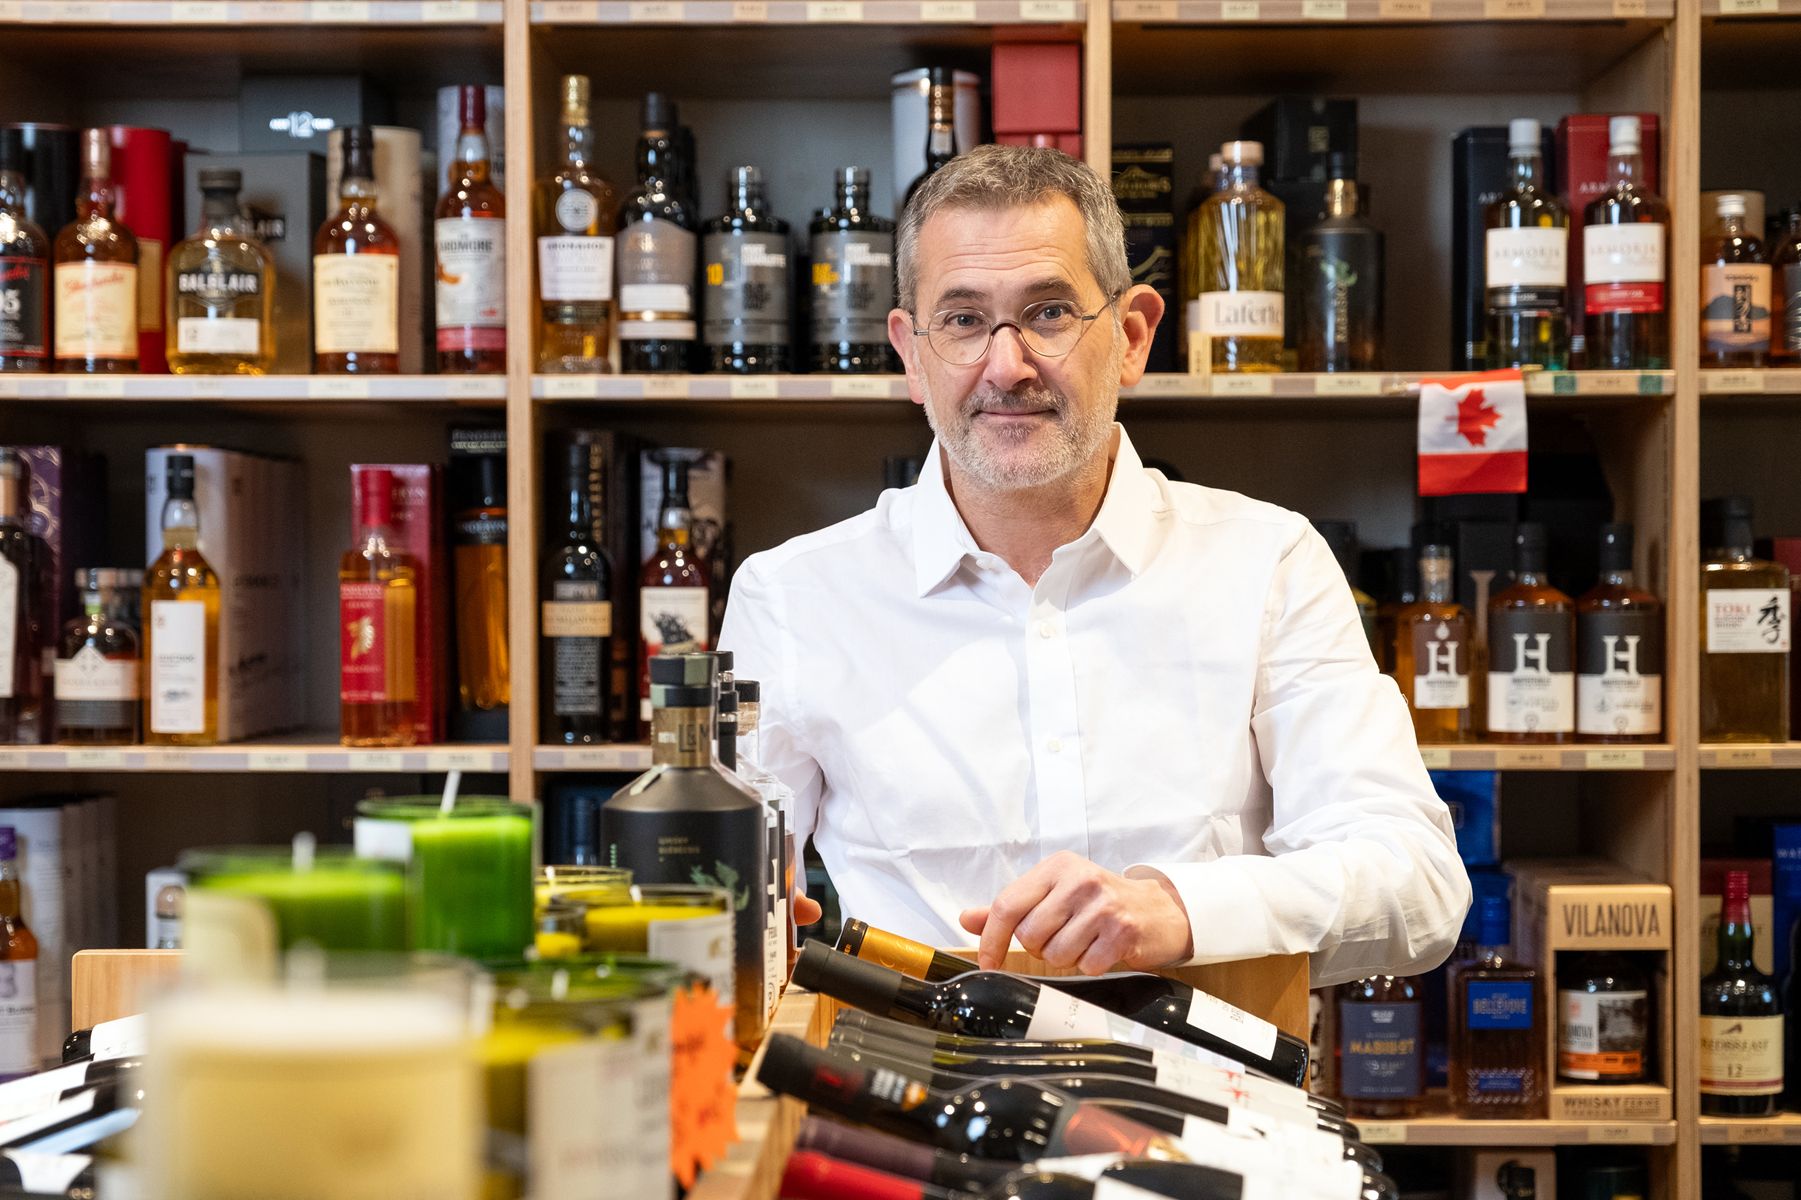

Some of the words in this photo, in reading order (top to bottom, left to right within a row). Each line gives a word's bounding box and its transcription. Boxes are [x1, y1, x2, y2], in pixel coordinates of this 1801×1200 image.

[1427, 641, 1459, 676] H
[1512, 633, 1551, 674] H
[1602, 635, 1641, 675] H
[1563, 904, 1661, 937] VILANOVA
[1727, 1063, 1744, 1079] 12
[1563, 1097, 1621, 1108] WHISKY
